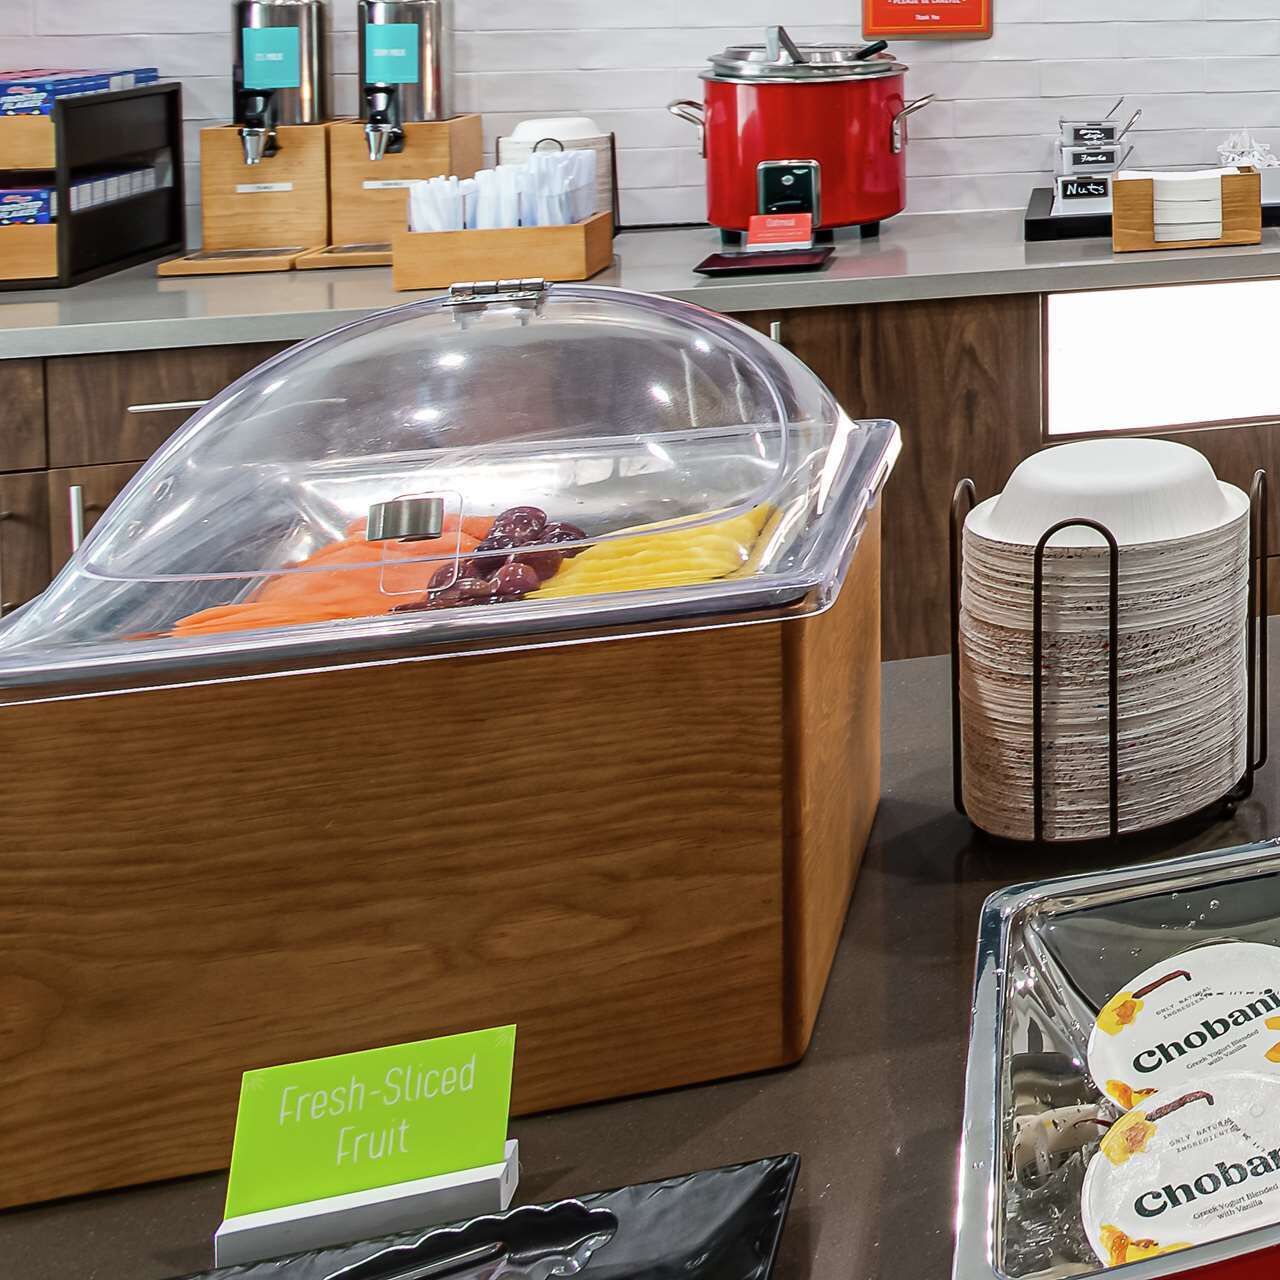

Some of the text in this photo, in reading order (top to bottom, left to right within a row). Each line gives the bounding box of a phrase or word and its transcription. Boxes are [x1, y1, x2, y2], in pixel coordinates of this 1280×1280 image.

[1066, 183, 1105, 195] Nuts
[1207, 1042, 1248, 1067] with Vanilla
[1208, 1042, 1232, 1060] Yogurt
[278, 1053, 477, 1126] Fresh-Sliced
[335, 1118, 411, 1166] Fruit
[1192, 1183, 1279, 1221] Greek Yogurt Blended
[1216, 1199, 1264, 1221] with Vanilla
